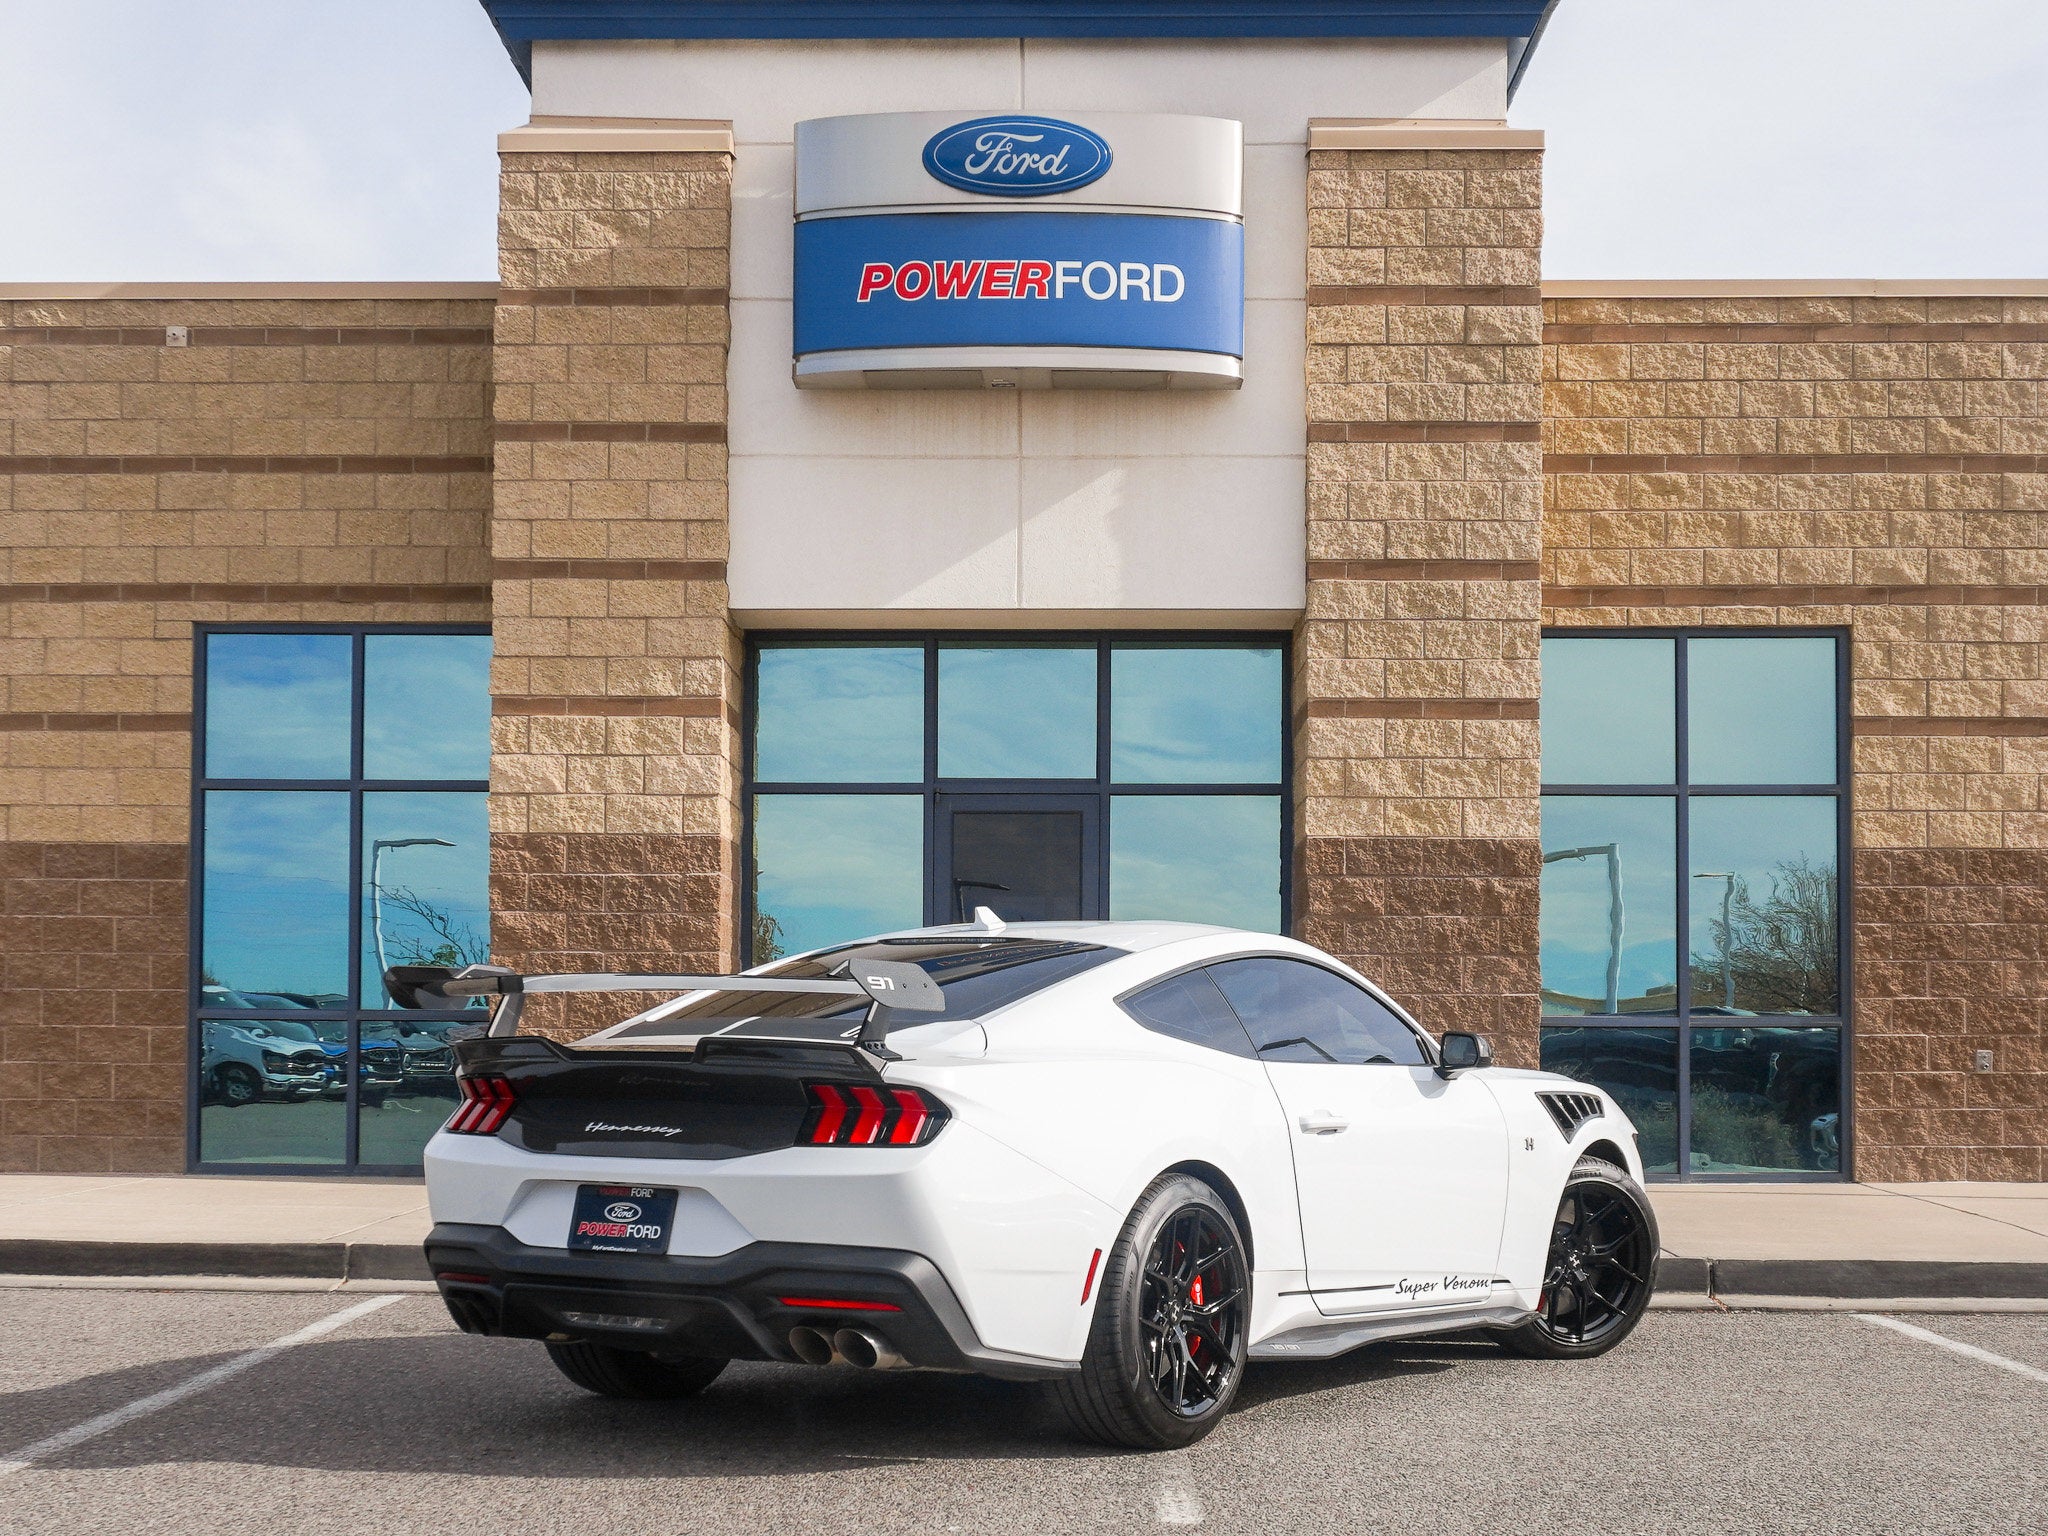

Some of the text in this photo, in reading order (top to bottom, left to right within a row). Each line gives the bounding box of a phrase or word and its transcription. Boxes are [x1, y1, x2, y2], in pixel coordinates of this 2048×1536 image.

[964, 131, 1071, 176] Ford
[856, 260, 1186, 303] POWERFORD
[867, 975, 895, 991] 91
[585, 1122, 683, 1137] Hennessey
[611, 1205, 634, 1218] Ford
[577, 1221, 661, 1239] POWERFORD
[1395, 1275, 1492, 1300] Super Venom
